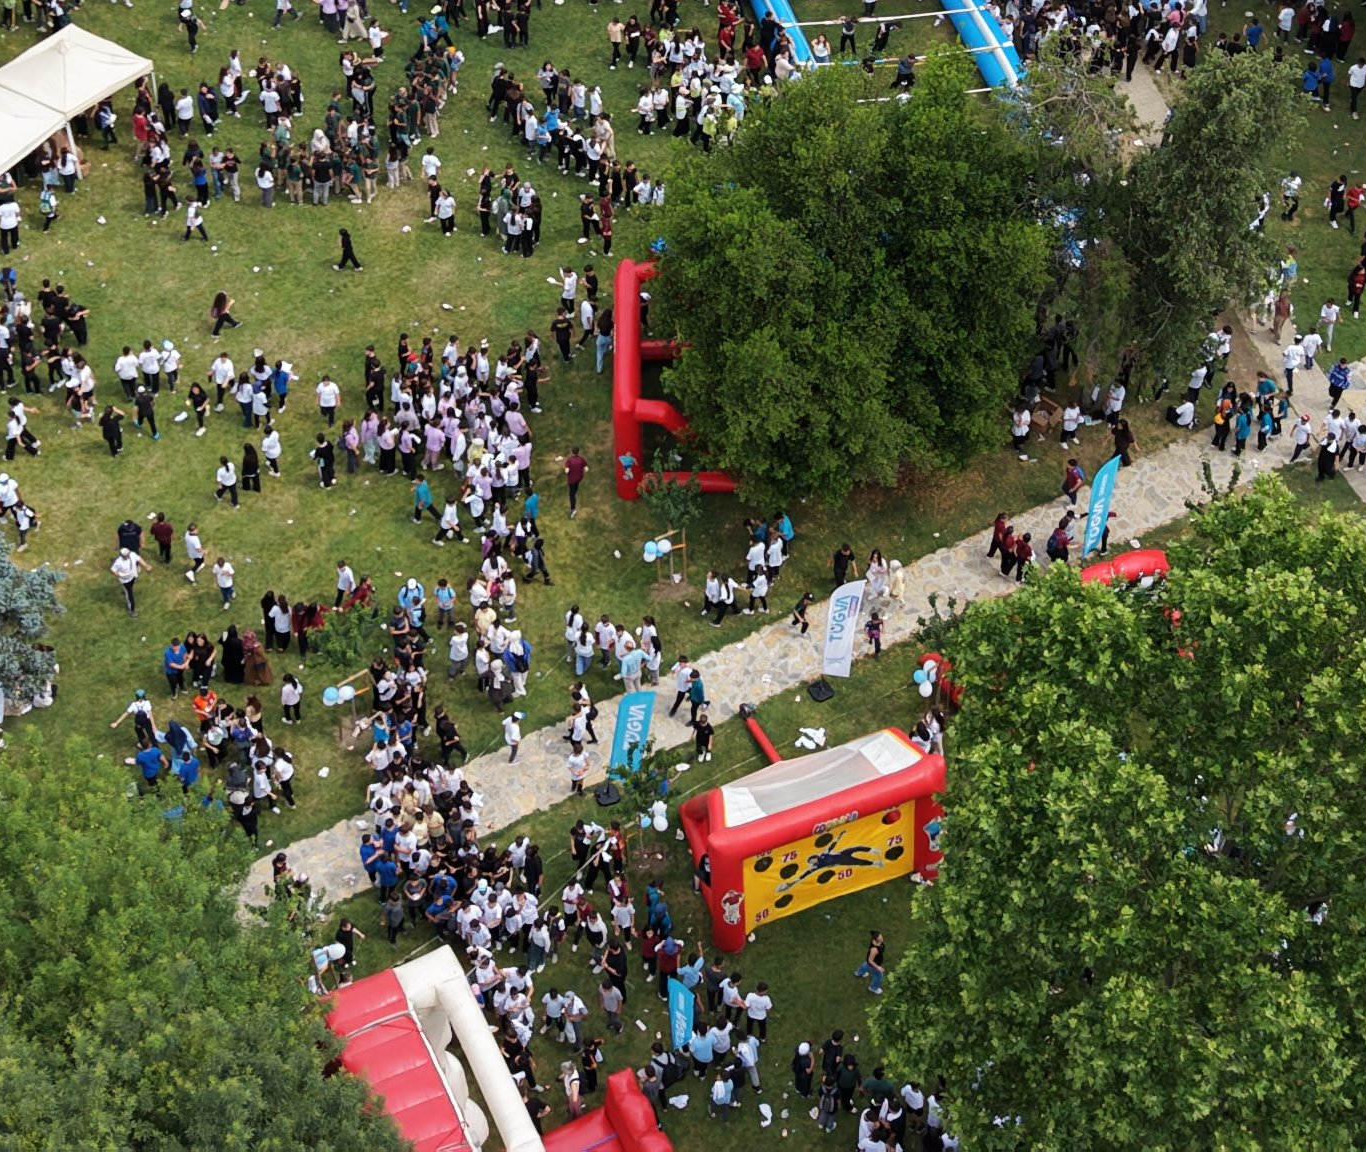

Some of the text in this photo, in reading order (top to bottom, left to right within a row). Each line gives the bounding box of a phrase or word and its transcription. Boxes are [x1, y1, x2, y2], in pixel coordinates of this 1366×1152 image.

[829, 595, 852, 643] TÜGVA
[888, 835, 903, 847] 75
[782, 851, 798, 863] 75
[838, 869, 853, 880] 50
[755, 909, 769, 922] 50
